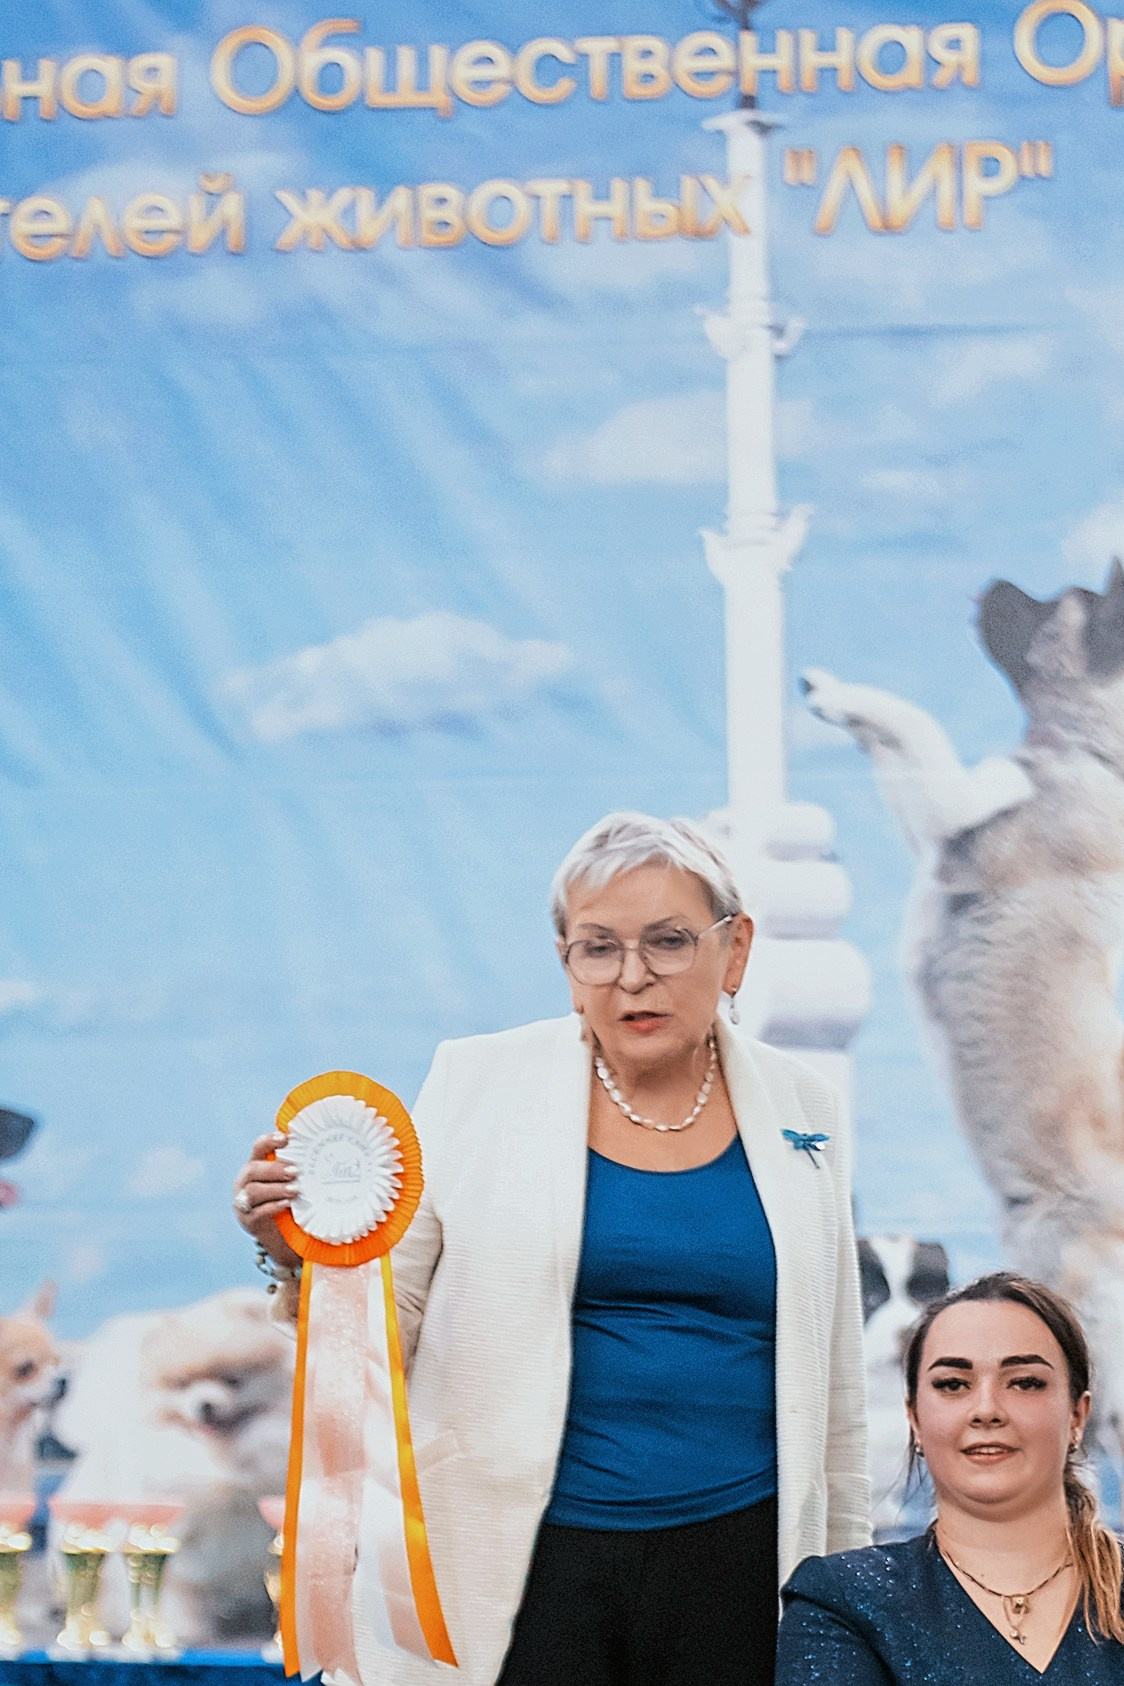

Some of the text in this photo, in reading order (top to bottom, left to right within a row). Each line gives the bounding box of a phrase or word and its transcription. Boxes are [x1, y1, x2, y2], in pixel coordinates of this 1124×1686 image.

[211, 17, 981, 117] Общественная
[274, 173, 752, 252] животных
[784, 140, 1053, 234] "ЛИР"
